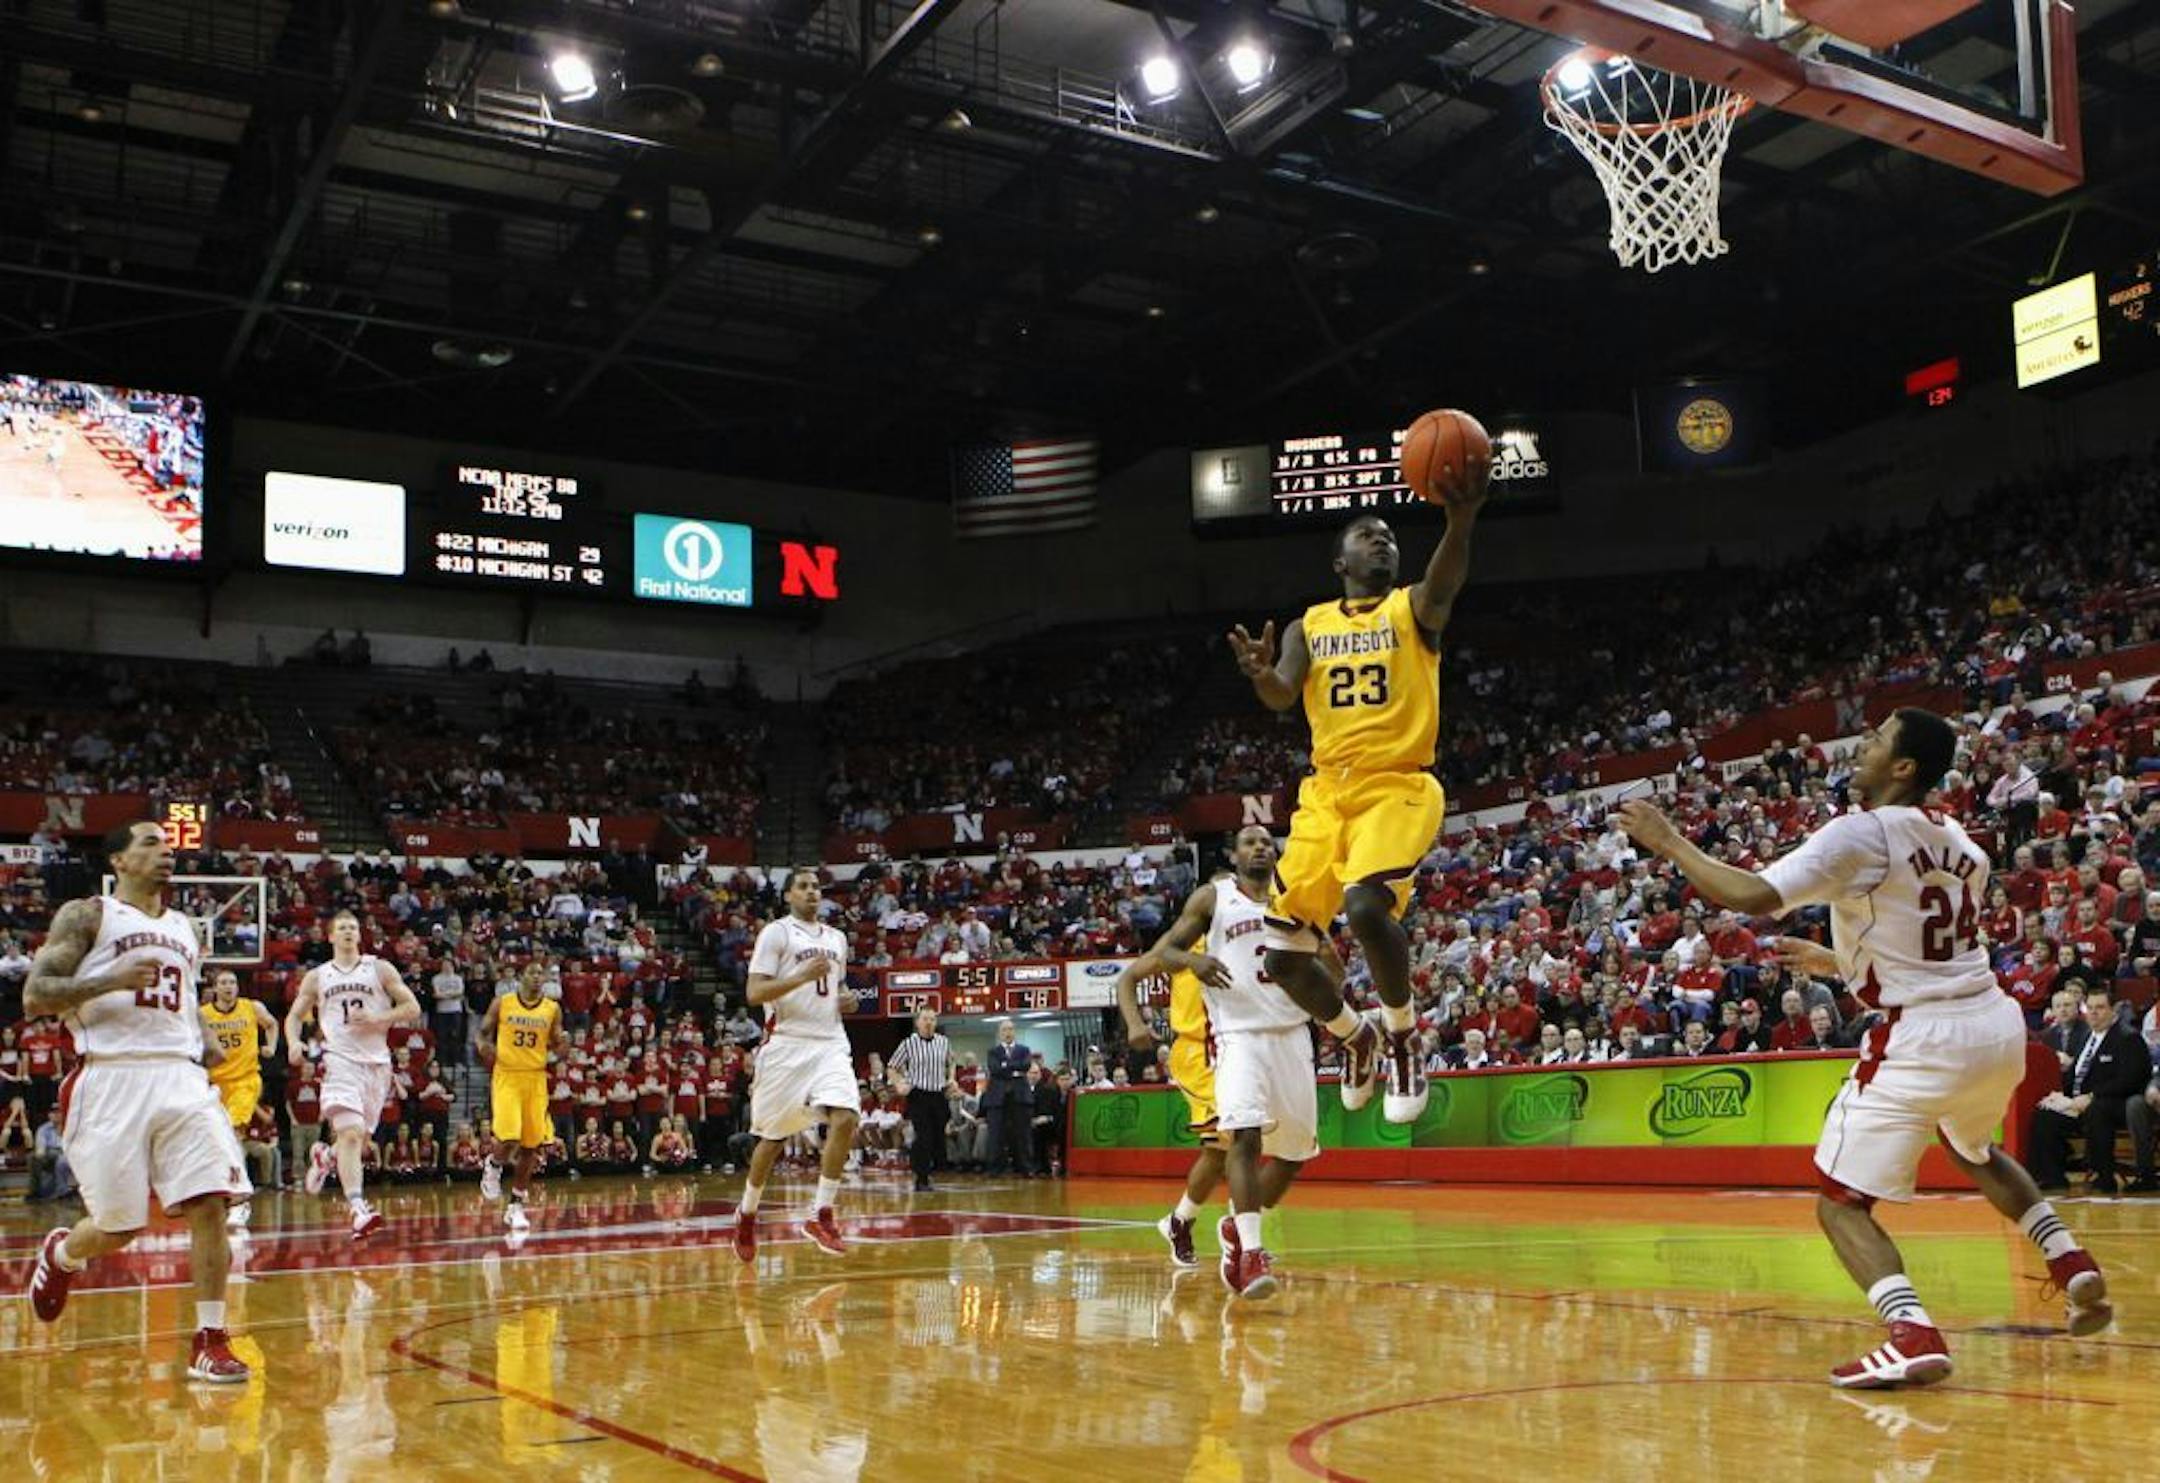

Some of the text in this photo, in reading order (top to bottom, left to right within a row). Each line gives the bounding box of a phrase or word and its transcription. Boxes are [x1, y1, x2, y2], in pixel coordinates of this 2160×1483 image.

[1488, 460, 1549, 481] didas
[273, 521, 349, 540] verizon
[436, 532, 474, 551] #22
[477, 536, 550, 558] MICHIGAN
[477, 558, 550, 581] MICHIGAN
[552, 565, 574, 582] ST
[780, 541, 838, 598] N
[640, 577, 746, 604] First National
[1311, 625, 1400, 659] MINNESOTA
[1329, 664, 1388, 709] 23
[1242, 794, 1275, 825] N
[568, 816, 602, 847] N
[953, 812, 984, 843] N
[1225, 918, 1264, 943] NEBR
[1920, 882, 1978, 961] 24
[115, 932, 195, 970] NEBRASKA
[135, 965, 182, 1013] 23
[218, 1033, 241, 1049] 55
[513, 1031, 538, 1048] 33
[1663, 1084, 1746, 1121] RUNZA
